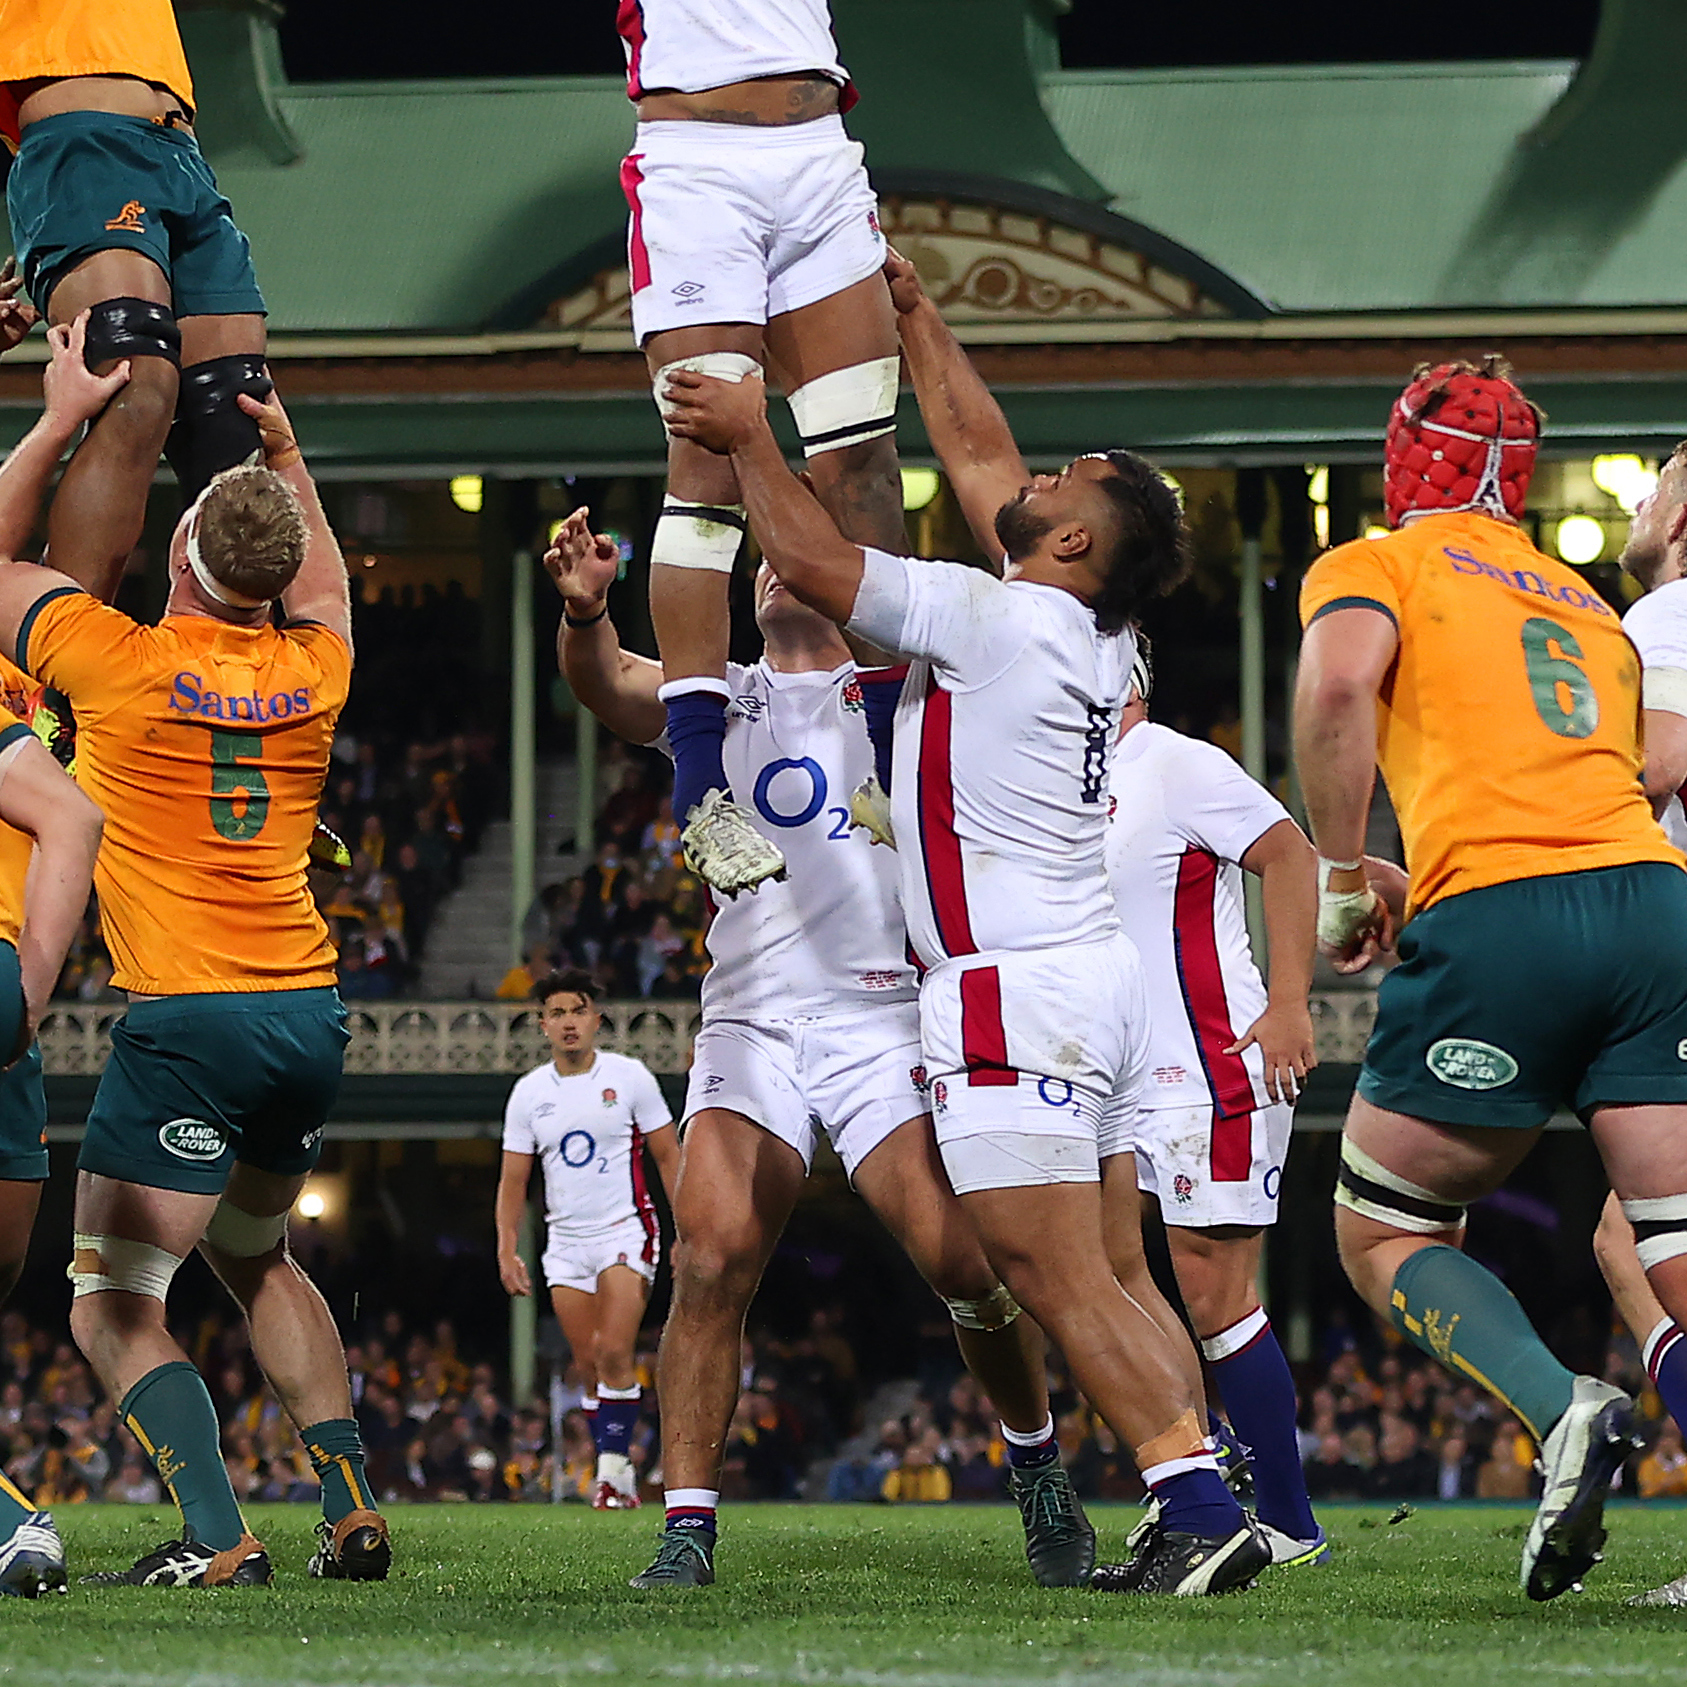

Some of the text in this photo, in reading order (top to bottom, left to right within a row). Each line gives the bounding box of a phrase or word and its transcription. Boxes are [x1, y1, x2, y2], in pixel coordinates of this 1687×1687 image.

[169, 671, 311, 723] Santos
[1520, 617, 1600, 740] 6
[209, 729, 272, 842] 5
[753, 755, 851, 841] O2
[176, 1125, 216, 1139] LAND
[176, 1138, 221, 1151] ROVER
[560, 1130, 610, 1174] O2
